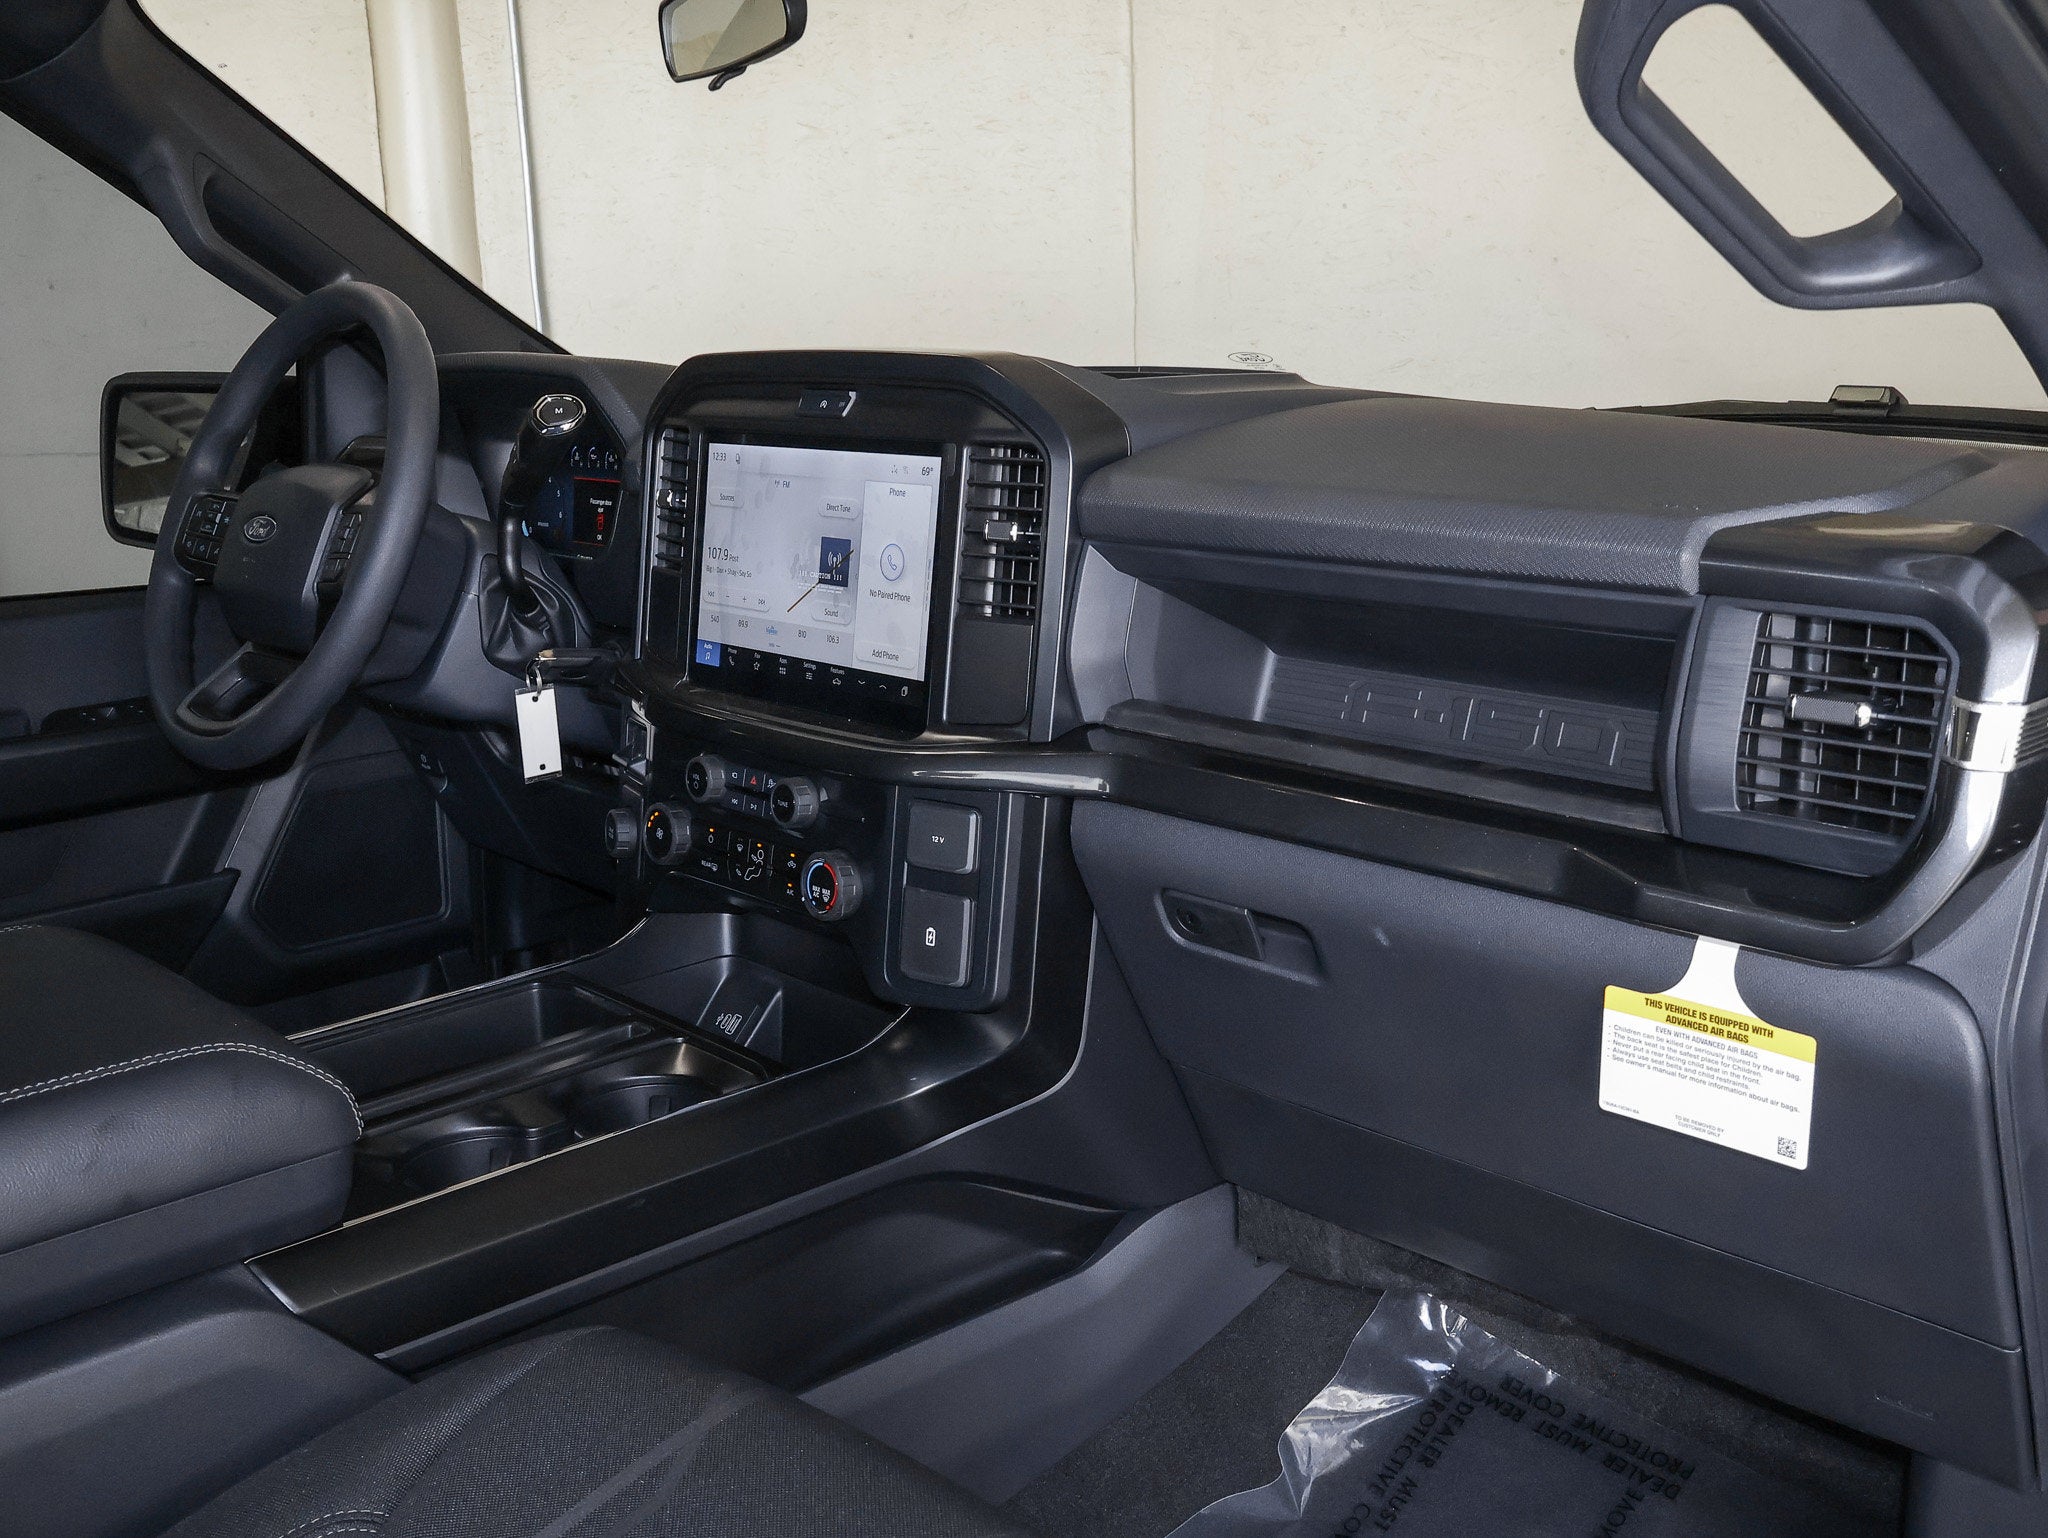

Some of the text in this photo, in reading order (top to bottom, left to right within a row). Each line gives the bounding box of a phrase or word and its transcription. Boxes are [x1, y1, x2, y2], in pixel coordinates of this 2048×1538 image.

[712, 452, 727, 461] 12:33
[826, 503, 851, 513] Direct Tune
[889, 487, 906, 497] Phone
[248, 517, 271, 537] Ford
[708, 547, 729, 561] 107.9
[869, 589, 911, 602] No Paired Phone
[824, 608, 839, 618] Sound
[871, 649, 899, 661] Add Phone
[931, 835, 939, 843] 12
[1645, 997, 1774, 1038] THIS VEHICLE IS EQUIPPED WITH
[1665, 1014, 1749, 1043] ADVANCED AIR BAGS
[1613, 1024, 1641, 1036] Children
[1642, 1032, 1654, 1040] can
[1666, 1037, 1684, 1048] killed
[1694, 1045, 1725, 1060] seriously
[1726, 1055, 1751, 1066] injured
[1752, 1061, 1761, 1070] by
[1762, 1064, 1774, 1073] the
[1613, 1031, 1626, 1040] The
[1627, 1035, 1642, 1044] back
[1644, 1040, 1658, 1048] seat
[1666, 1045, 1677, 1053] the
[1679, 1049, 1700, 1060] safest
[1700, 1055, 1719, 1066] place
[1720, 1060, 1731, 1068] for
[1655, 1025, 1758, 1059] EVEN WITH ADVANCED AIR BAGS
[1612, 1039, 1632, 1049] Never
[1633, 1045, 1644, 1053] put
[1651, 1050, 1664, 1058] rear
[1665, 1053, 1687, 1065] facing
[1687, 1060, 1705, 1069] child
[1706, 1064, 1720, 1073] seat
[1730, 1070, 1741, 1079] the
[1612, 1047, 1636, 1058] Always
[1637, 1054, 1650, 1062] use
[1651, 1057, 1664, 1065] seat
[1666, 1061, 1682, 1071] belts
[1683, 1066, 1697, 1075] and
[1697, 1069, 1715, 1080] child
[1612, 1053, 1625, 1063] See
[1652, 1065, 1677, 1077] manual
[1678, 1072, 1688, 1080] for
[1689, 1075, 1707, 1085] more
[1707, 1080, 1747, 1097] information
[1748, 1093, 1769, 1103] about
[1500, 1373, 1696, 1481] PROTECTIVE COVER
[1532, 1420, 1593, 1454] MUST
[1374, 1401, 1474, 1533] DEALER MUST
[1603, 1451, 1682, 1500] DEALER
